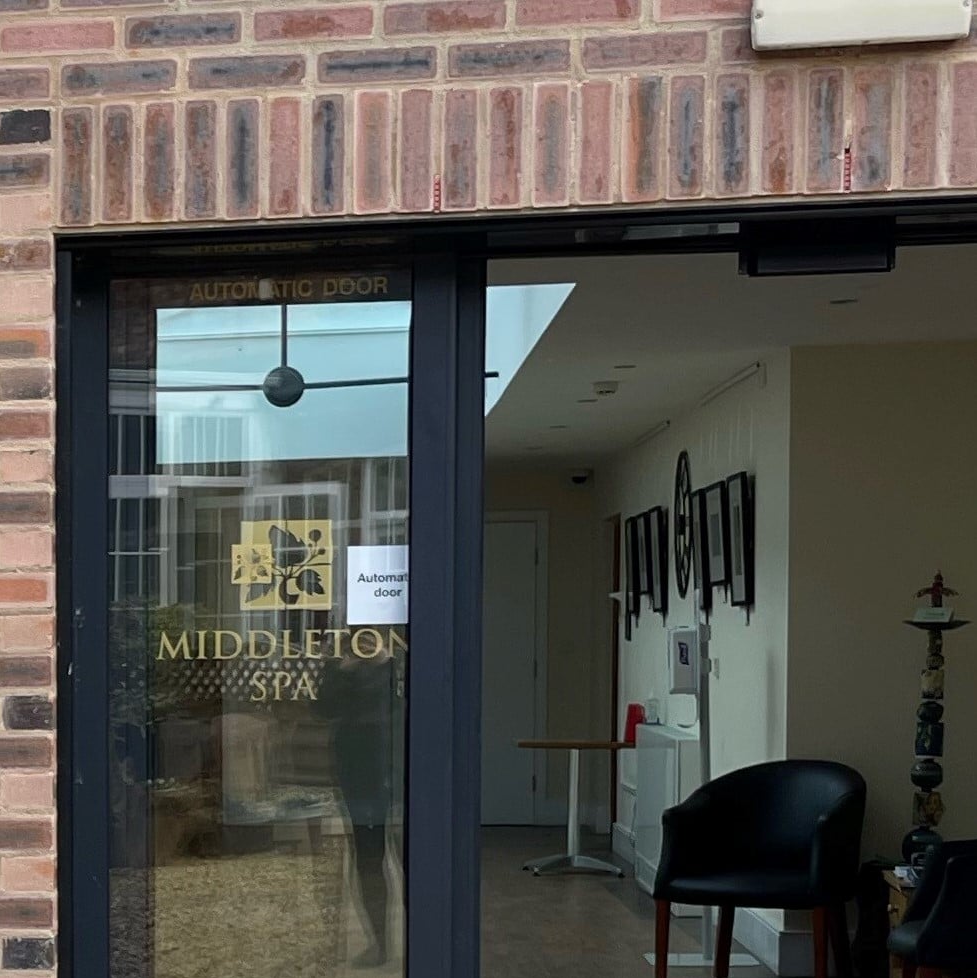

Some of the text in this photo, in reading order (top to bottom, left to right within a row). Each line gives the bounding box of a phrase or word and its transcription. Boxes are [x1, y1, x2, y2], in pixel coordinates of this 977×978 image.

[323, 276, 389, 297] DOOR
[374, 587, 403, 597] door
[155, 628, 408, 661] MIDDLETON
[250, 670, 318, 701] SPA
